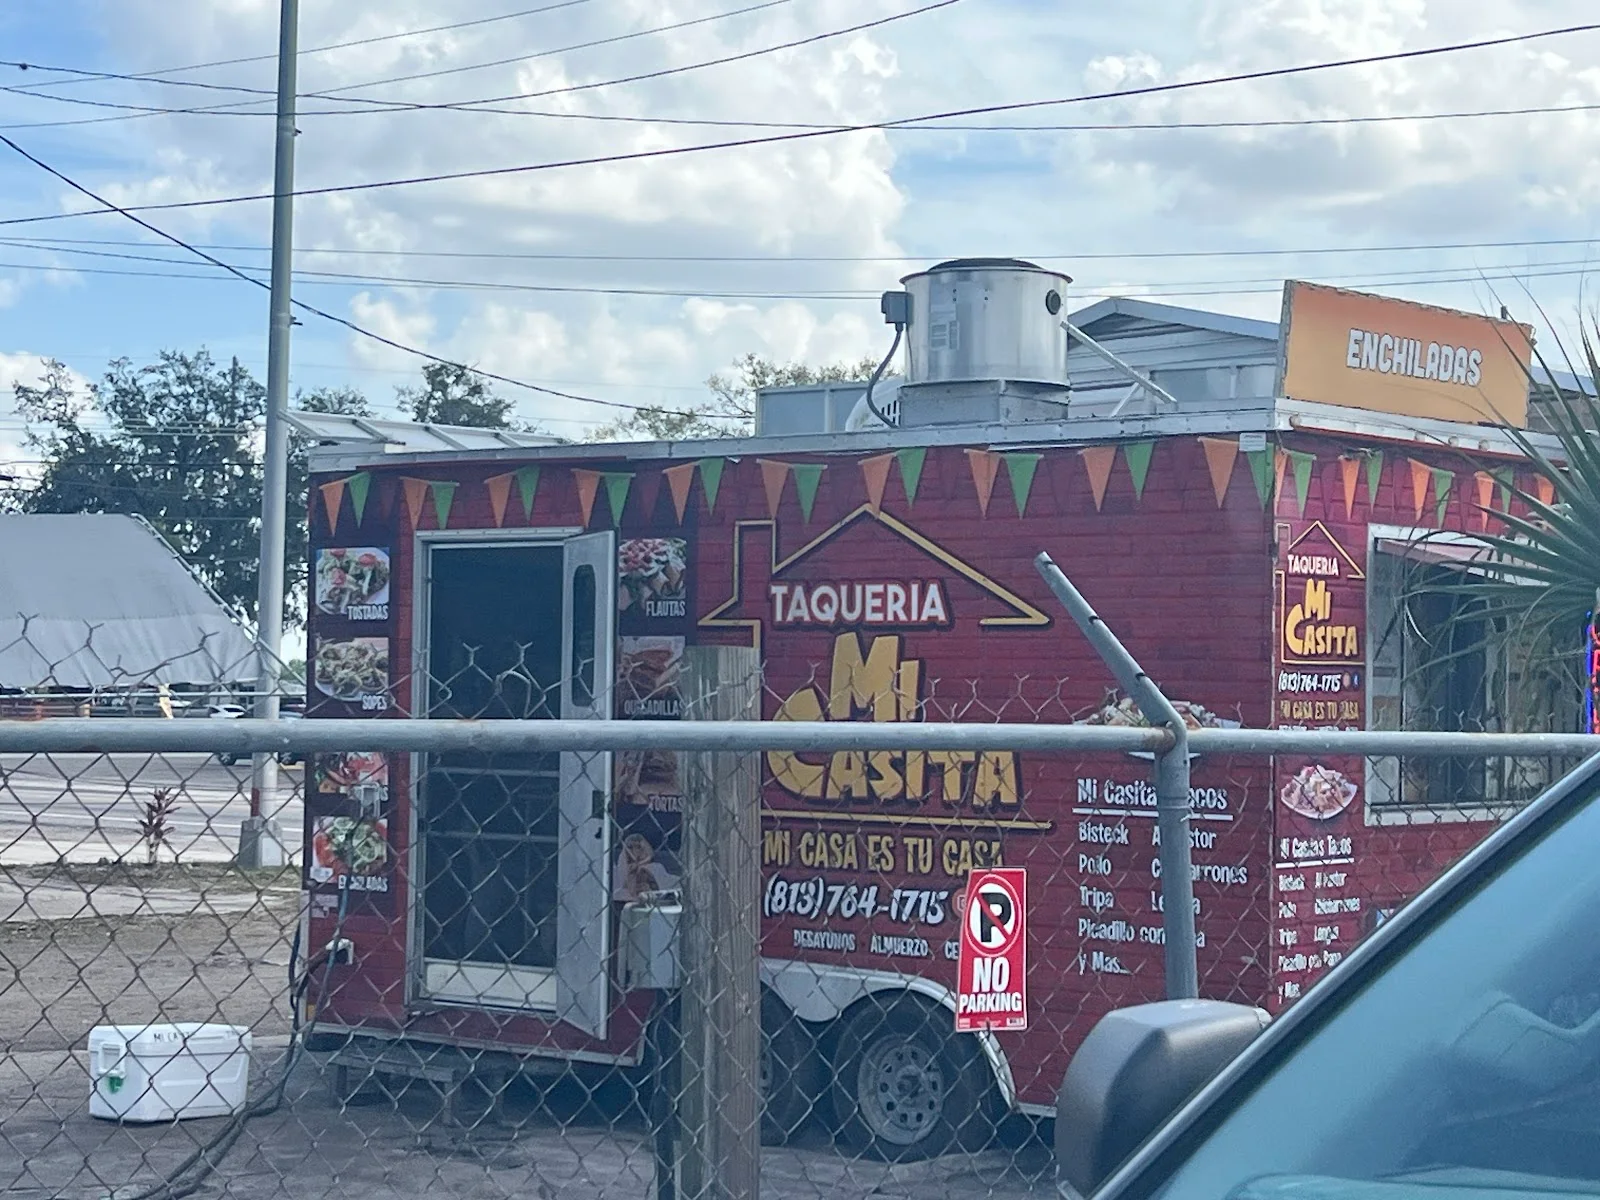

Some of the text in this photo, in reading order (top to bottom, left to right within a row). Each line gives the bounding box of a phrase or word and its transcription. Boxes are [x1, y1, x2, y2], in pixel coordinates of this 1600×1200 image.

[1347, 328, 1482, 387] ENCHILADAS
[1288, 554, 1339, 576] TAQUERIA
[347, 605, 389, 620] TOSTADAS
[646, 601, 685, 616] FLAUTAS
[771, 584, 947, 622] TAQUERIA
[1286, 604, 1358, 656] CASITA
[362, 695, 387, 710] SOPES
[767, 688, 1017, 805] CASITA
[650, 795, 685, 812] TORTAS
[1078, 779, 1098, 803] Mi
[1188, 787, 1228, 809] acos
[1079, 823, 1129, 845] Bisteck
[764, 831, 1003, 877] MI CASA ES TU CASA
[764, 872, 948, 924] (813)764-1715
[1080, 886, 1114, 913] Tripa
[793, 929, 856, 951] DESAYUNOS
[870, 934, 928, 957] ALMUERZO
[1079, 918, 1135, 942] Picadillo
[972, 957, 1010, 993] NO
[959, 992, 1023, 1014] PARKING
